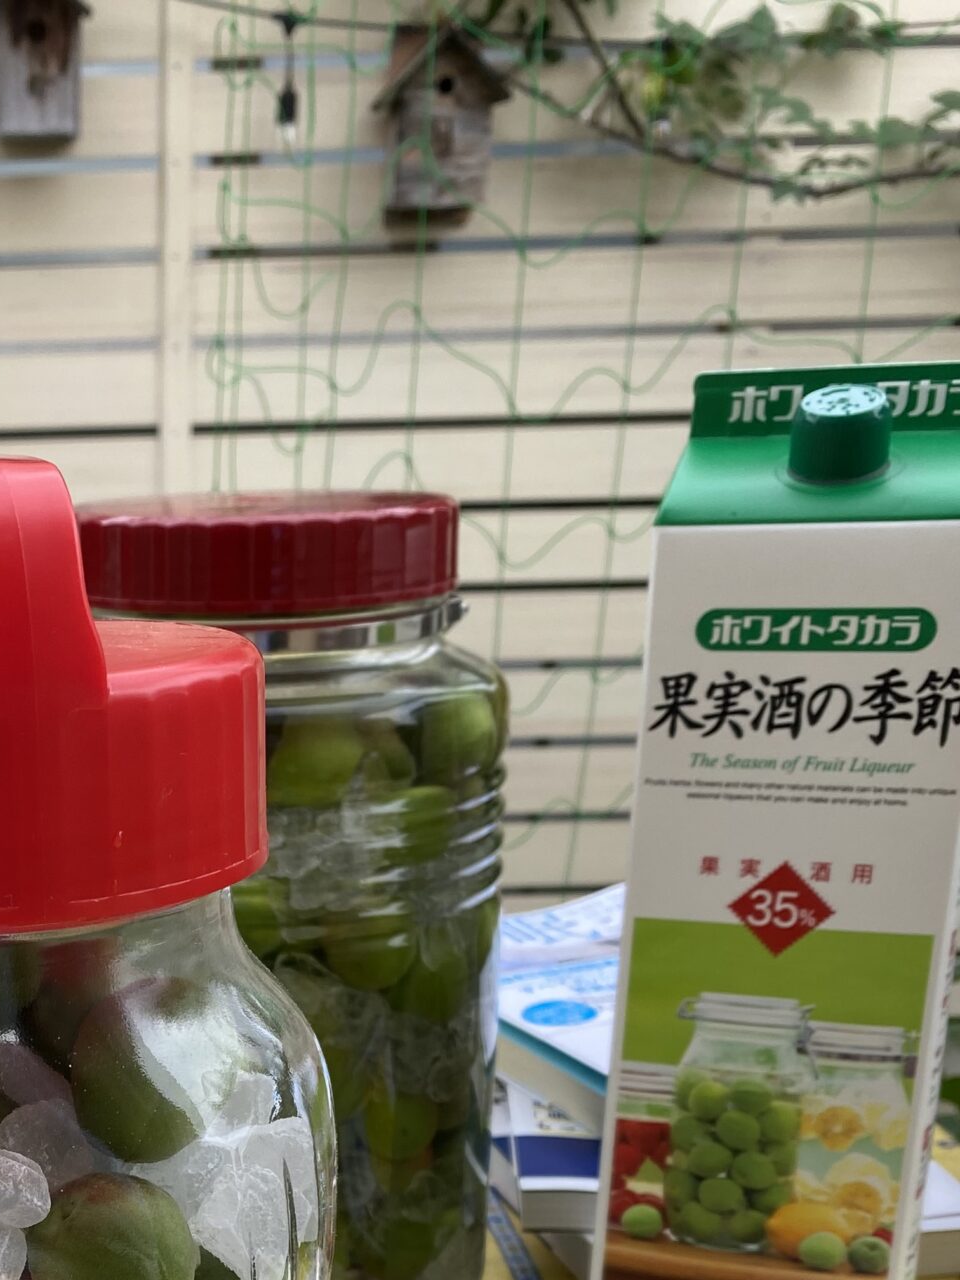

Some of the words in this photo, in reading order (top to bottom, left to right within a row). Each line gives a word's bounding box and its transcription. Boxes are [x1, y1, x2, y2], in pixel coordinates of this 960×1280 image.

[708, 614, 922, 646] ホワイトタカラ
[648, 666, 960, 747] 果実酒の季節
[690, 752, 719, 769] The
[723, 753, 777, 770] Season
[782, 755, 800, 776] of
[803, 755, 845, 773] Fruit
[849, 757, 916, 778] Liqueur
[746, 888, 817, 929] 35%
